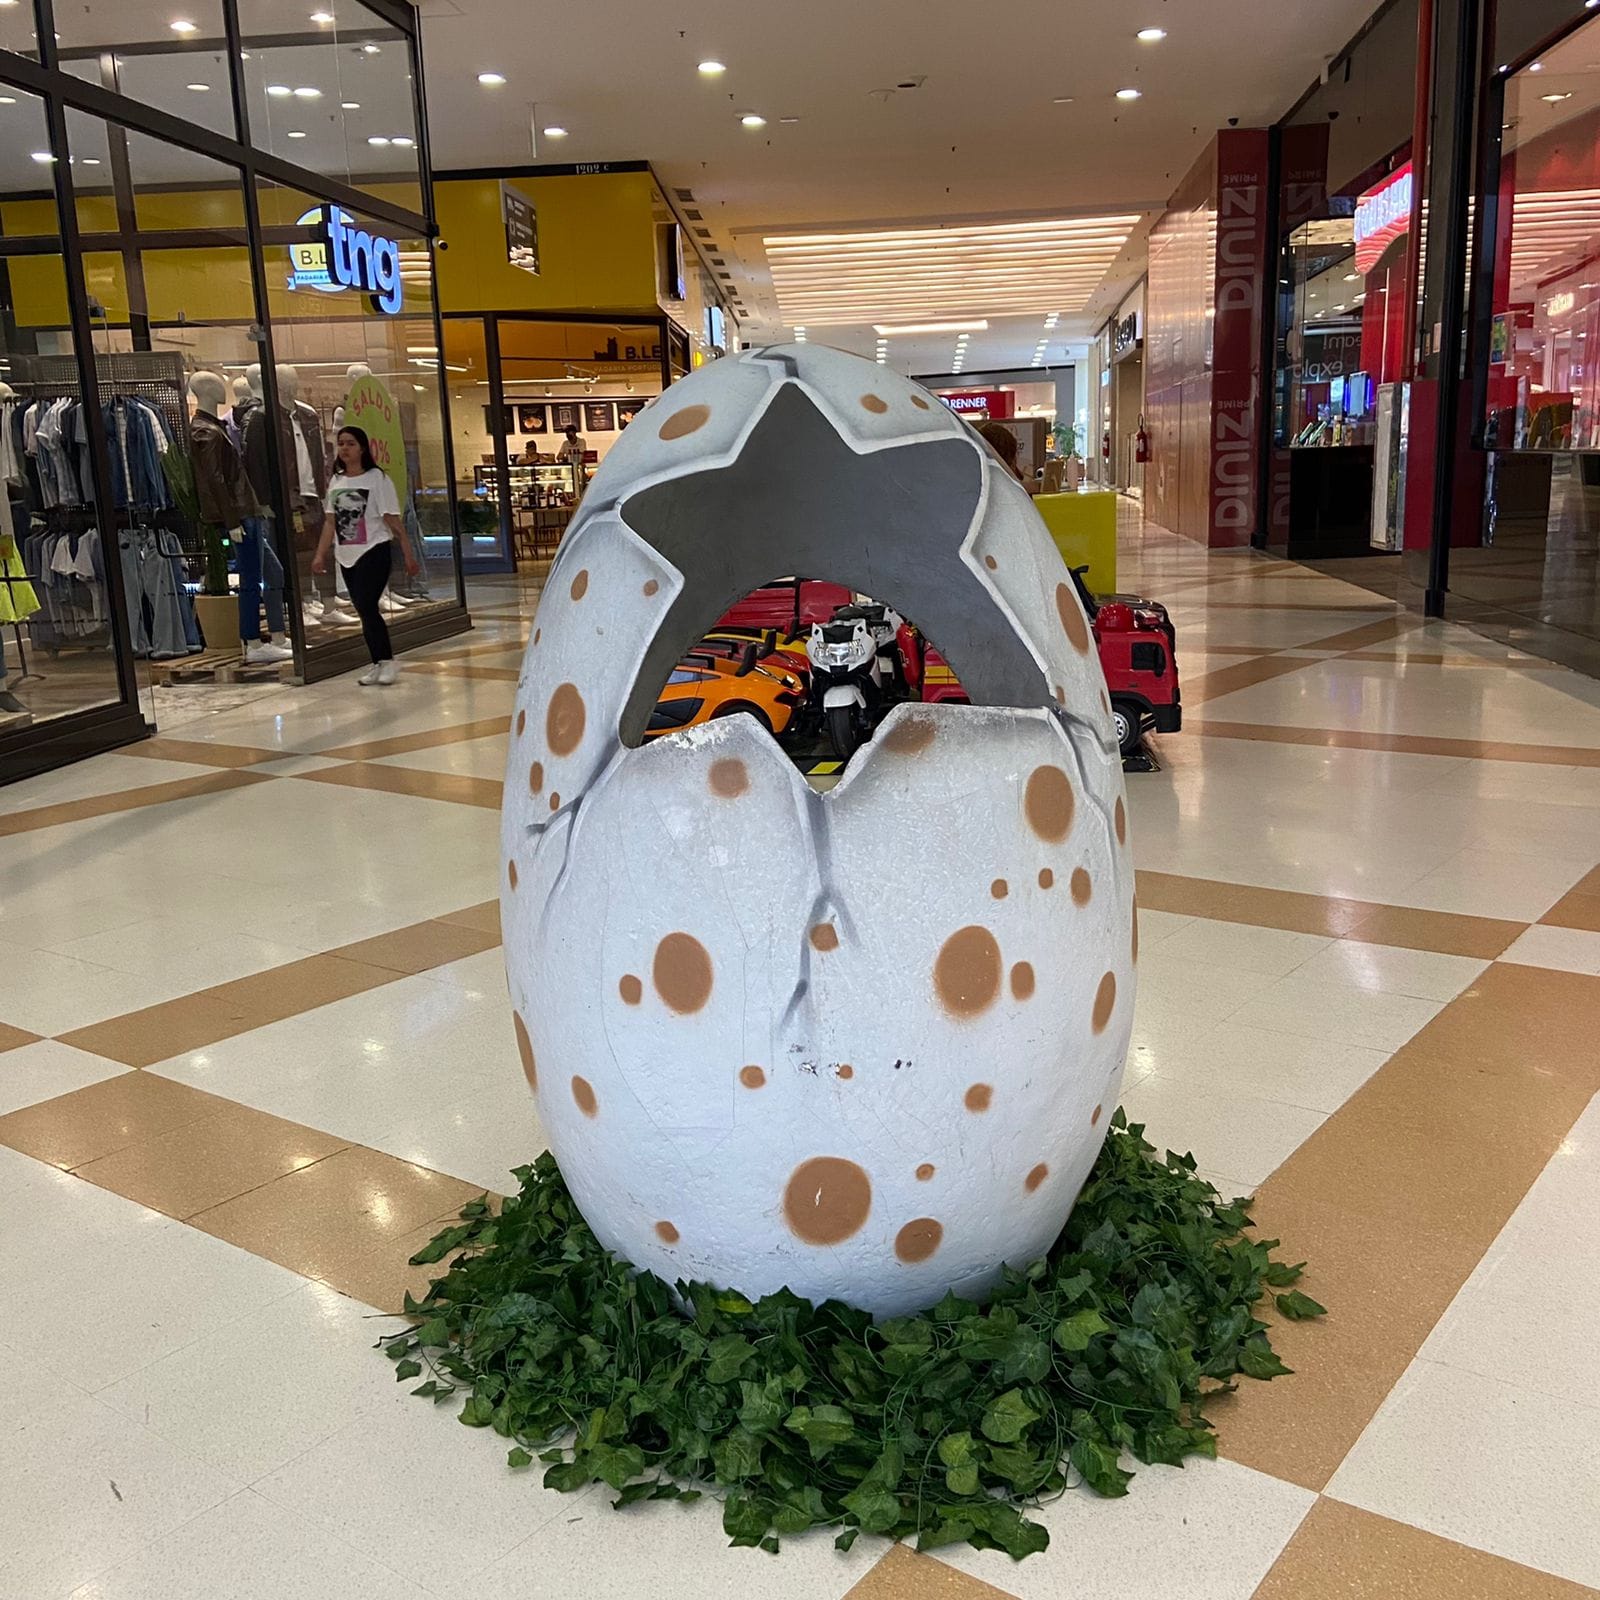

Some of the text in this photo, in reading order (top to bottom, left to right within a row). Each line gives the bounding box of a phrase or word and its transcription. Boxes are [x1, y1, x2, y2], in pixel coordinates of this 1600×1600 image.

[1223, 173, 1258, 184] PRIME
[328, 204, 402, 315] tng
[1218, 186, 1257, 310] DINIZ
[625, 345, 662, 359] B.LE
[352, 387, 392, 423] SALDO
[949, 396, 987, 409] RENNER
[368, 437, 391, 465] 0%
[1214, 410, 1252, 528] DINIZ
